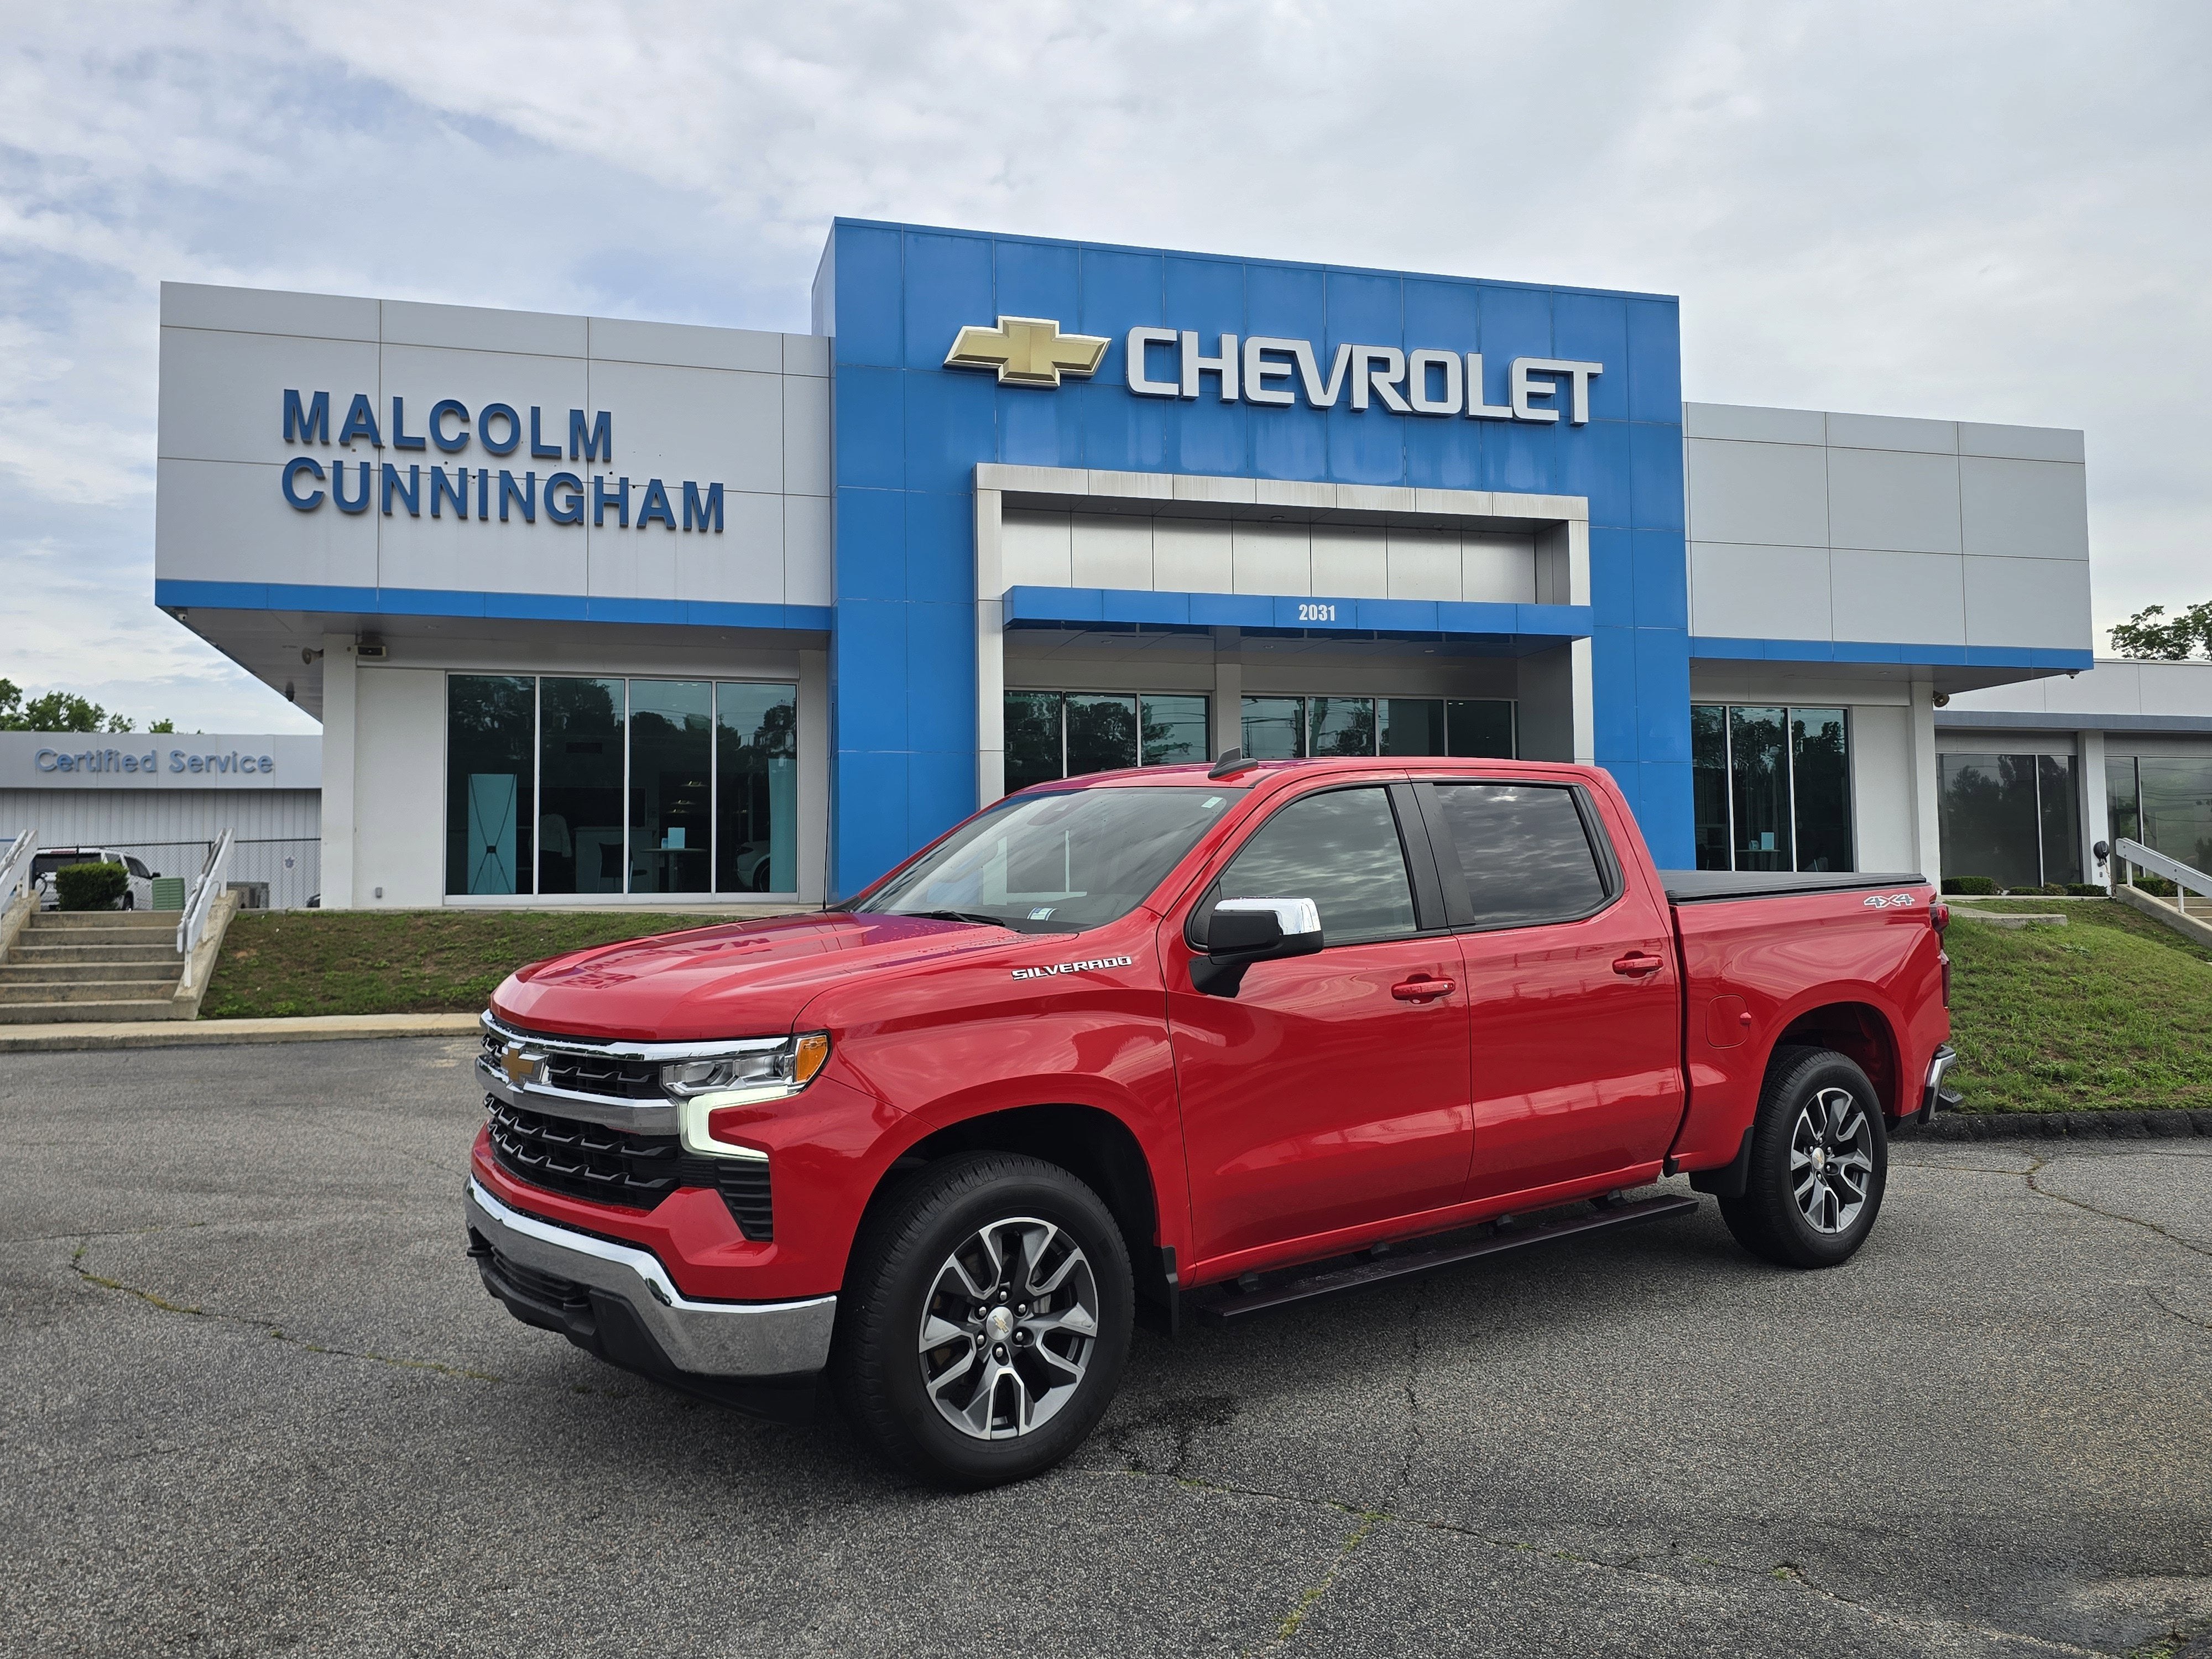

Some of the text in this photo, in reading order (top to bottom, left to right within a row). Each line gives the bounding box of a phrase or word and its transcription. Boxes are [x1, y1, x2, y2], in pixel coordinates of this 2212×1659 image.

[1126, 326, 1603, 426] CHEVROLET
[283, 389, 612, 462] MALCOLM
[281, 457, 724, 533] CUNNINGHAM
[1298, 604, 1335, 621] 2031
[34, 748, 274, 774] Certified Service
[1011, 956, 1133, 981] SILVERADO
